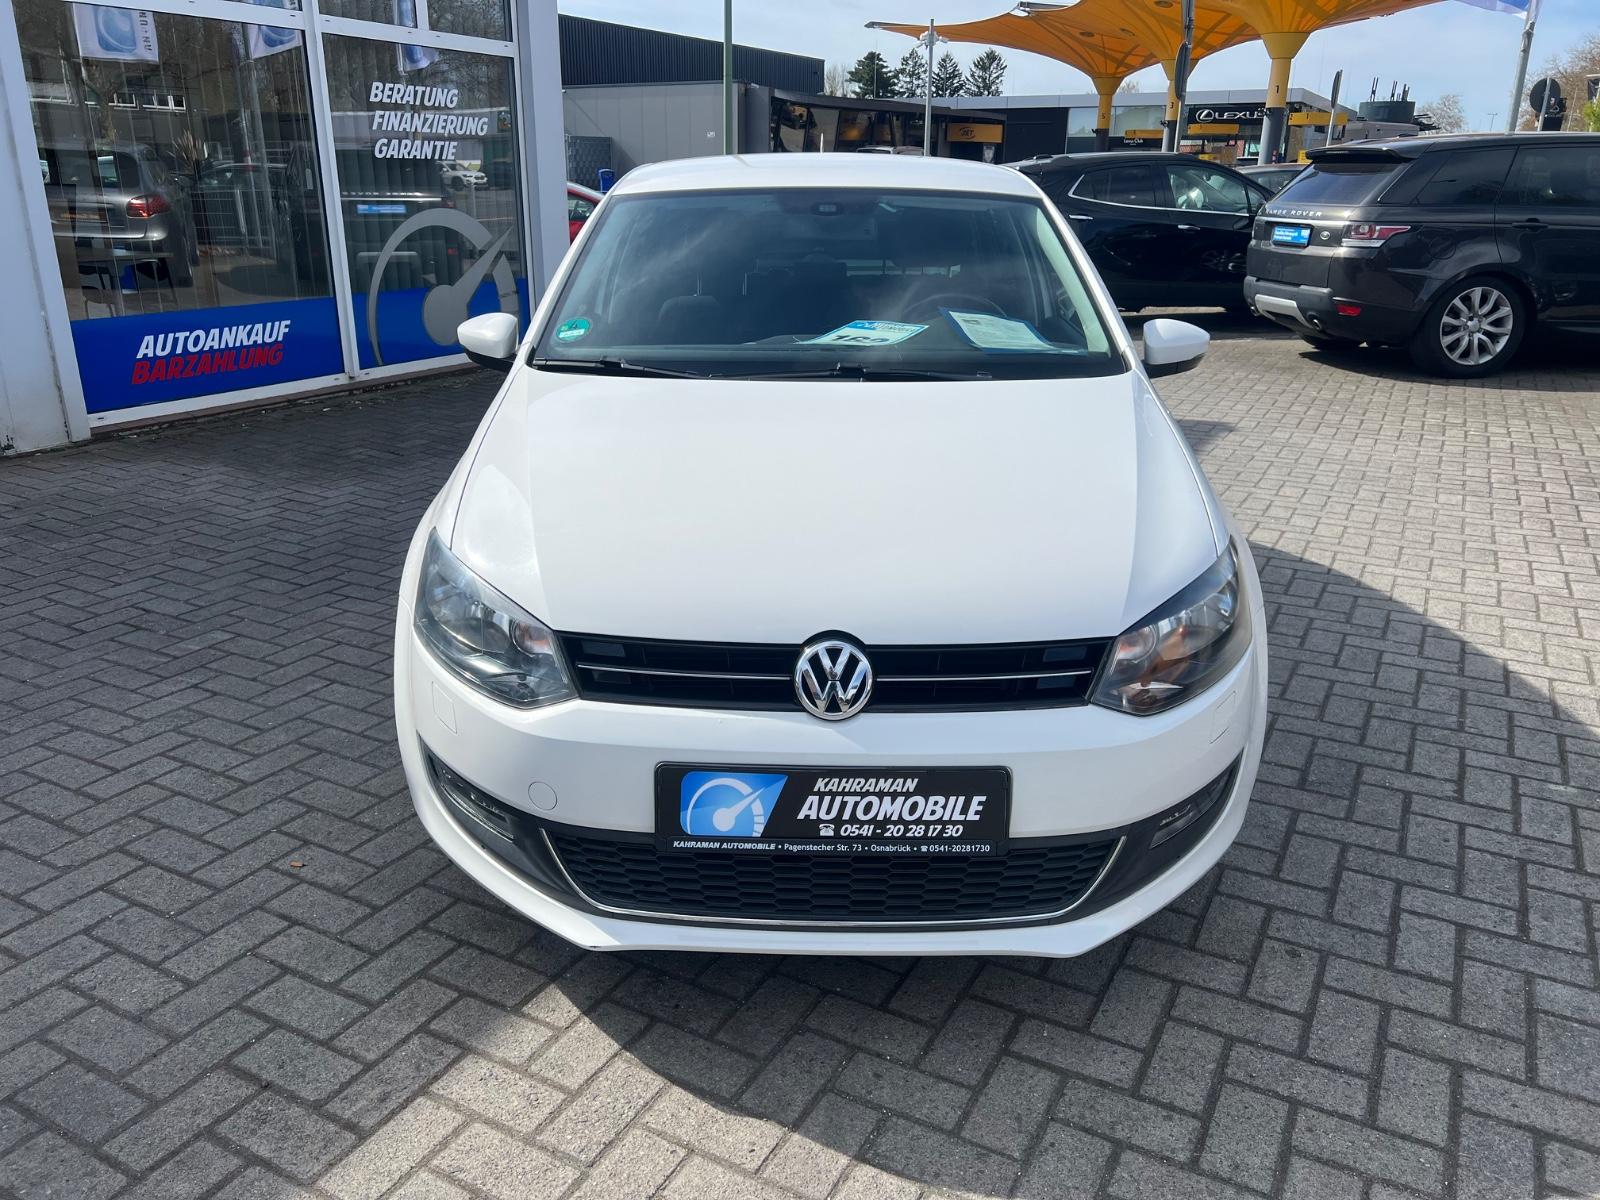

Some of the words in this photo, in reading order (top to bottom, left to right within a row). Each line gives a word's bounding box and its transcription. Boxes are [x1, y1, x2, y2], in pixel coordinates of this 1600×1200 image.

[369, 81, 458, 108] BERATUNG
[372, 110, 488, 136] FINANZIERUNG
[374, 138, 458, 160] GARANTIE
[136, 320, 291, 358] AUTOANKAUF
[132, 343, 284, 384] BARZAHLUNG
[814, 778, 918, 793] KAHRAMAN
[797, 795, 987, 821] AUTOMOBILE
[840, 824, 874, 837] 0541
[884, 824, 904, 837] 20
[906, 825, 925, 837] 28
[927, 825, 942, 837] 17
[943, 825, 963, 837] 30
[673, 840, 720, 849] KAHRAMAN
[721, 842, 776, 850] AUTOMOBILE
[784, 843, 835, 853] Pagenstecher
[837, 844, 850, 852] Str.
[870, 844, 911, 852] Osnabrück
[929, 844, 990, 852] 0541-20281730
